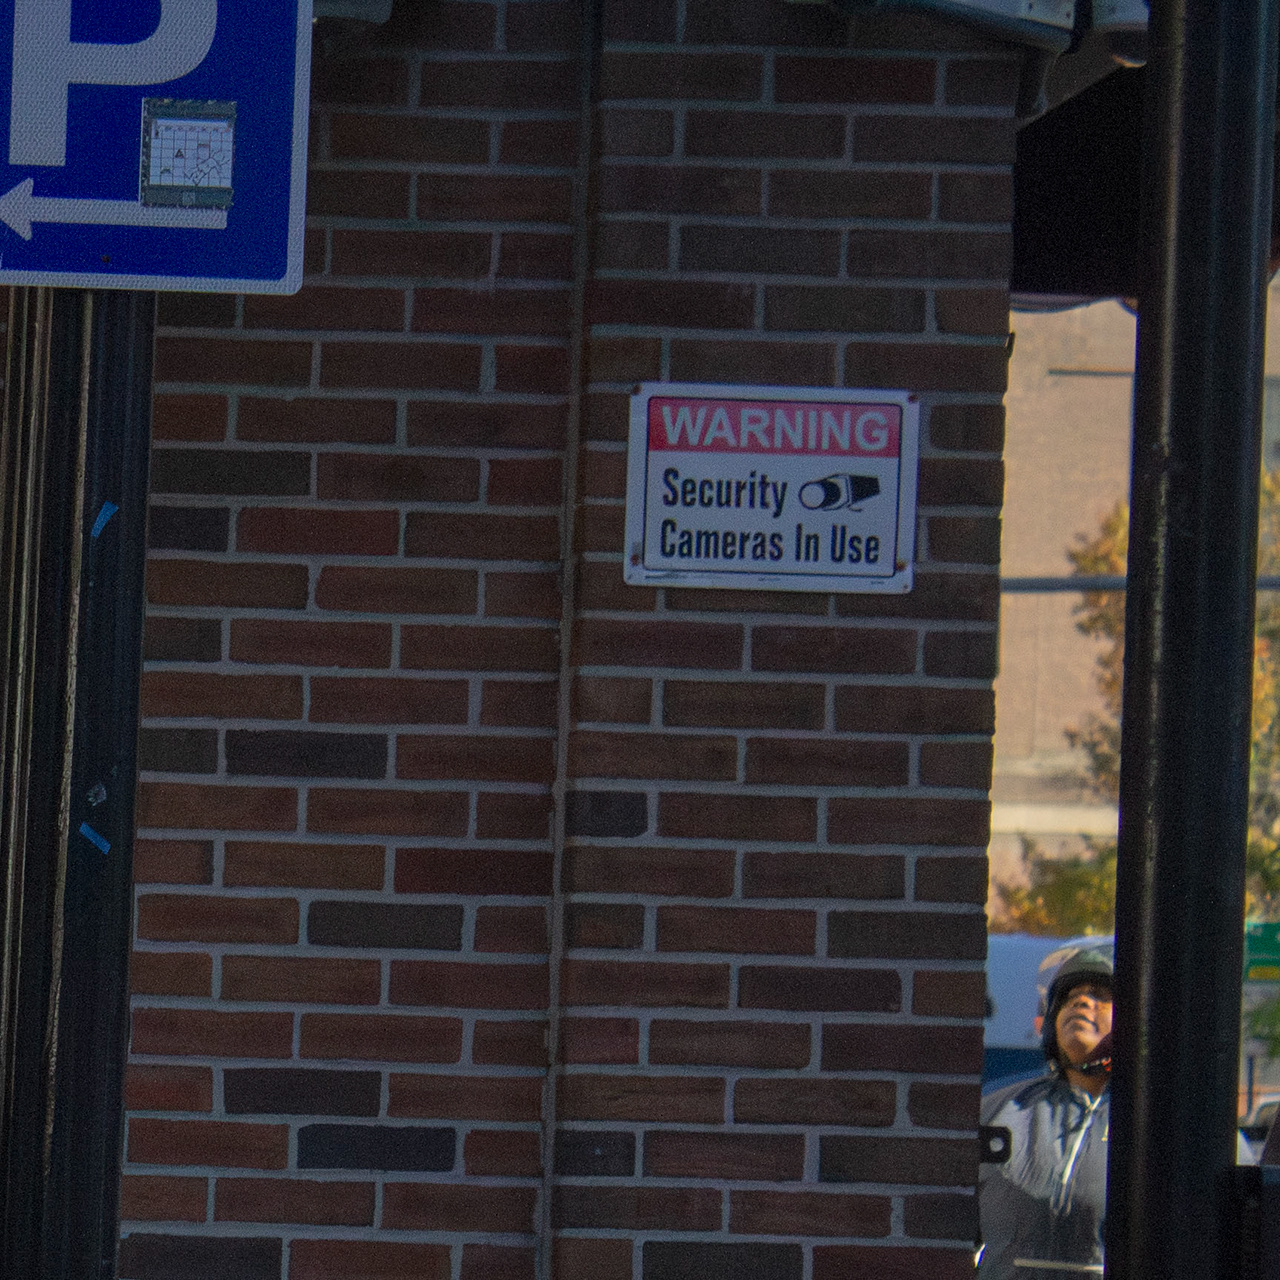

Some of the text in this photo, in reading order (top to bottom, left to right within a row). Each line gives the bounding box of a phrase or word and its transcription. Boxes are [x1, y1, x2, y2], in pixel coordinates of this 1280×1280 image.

[661, 404, 889, 451] WARNING
[663, 467, 787, 518] Security
[661, 519, 880, 564] Cameras In Use
